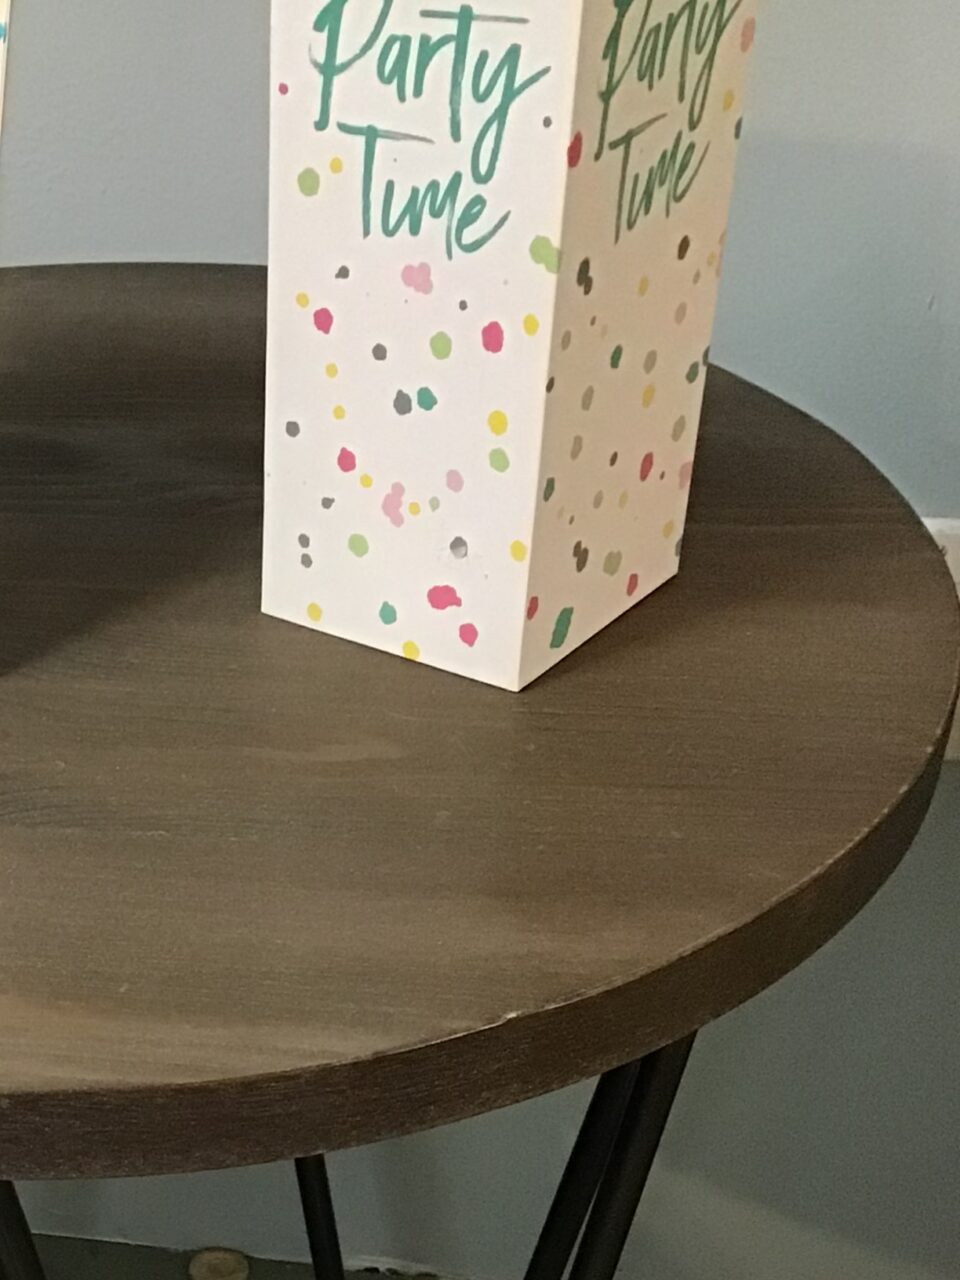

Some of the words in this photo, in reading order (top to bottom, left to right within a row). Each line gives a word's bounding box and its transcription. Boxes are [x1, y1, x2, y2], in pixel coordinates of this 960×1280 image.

[310, 0, 551, 184] Party
[595, 0, 742, 162] Party
[337, 121, 511, 260] Time
[608, 112, 711, 245] Time
